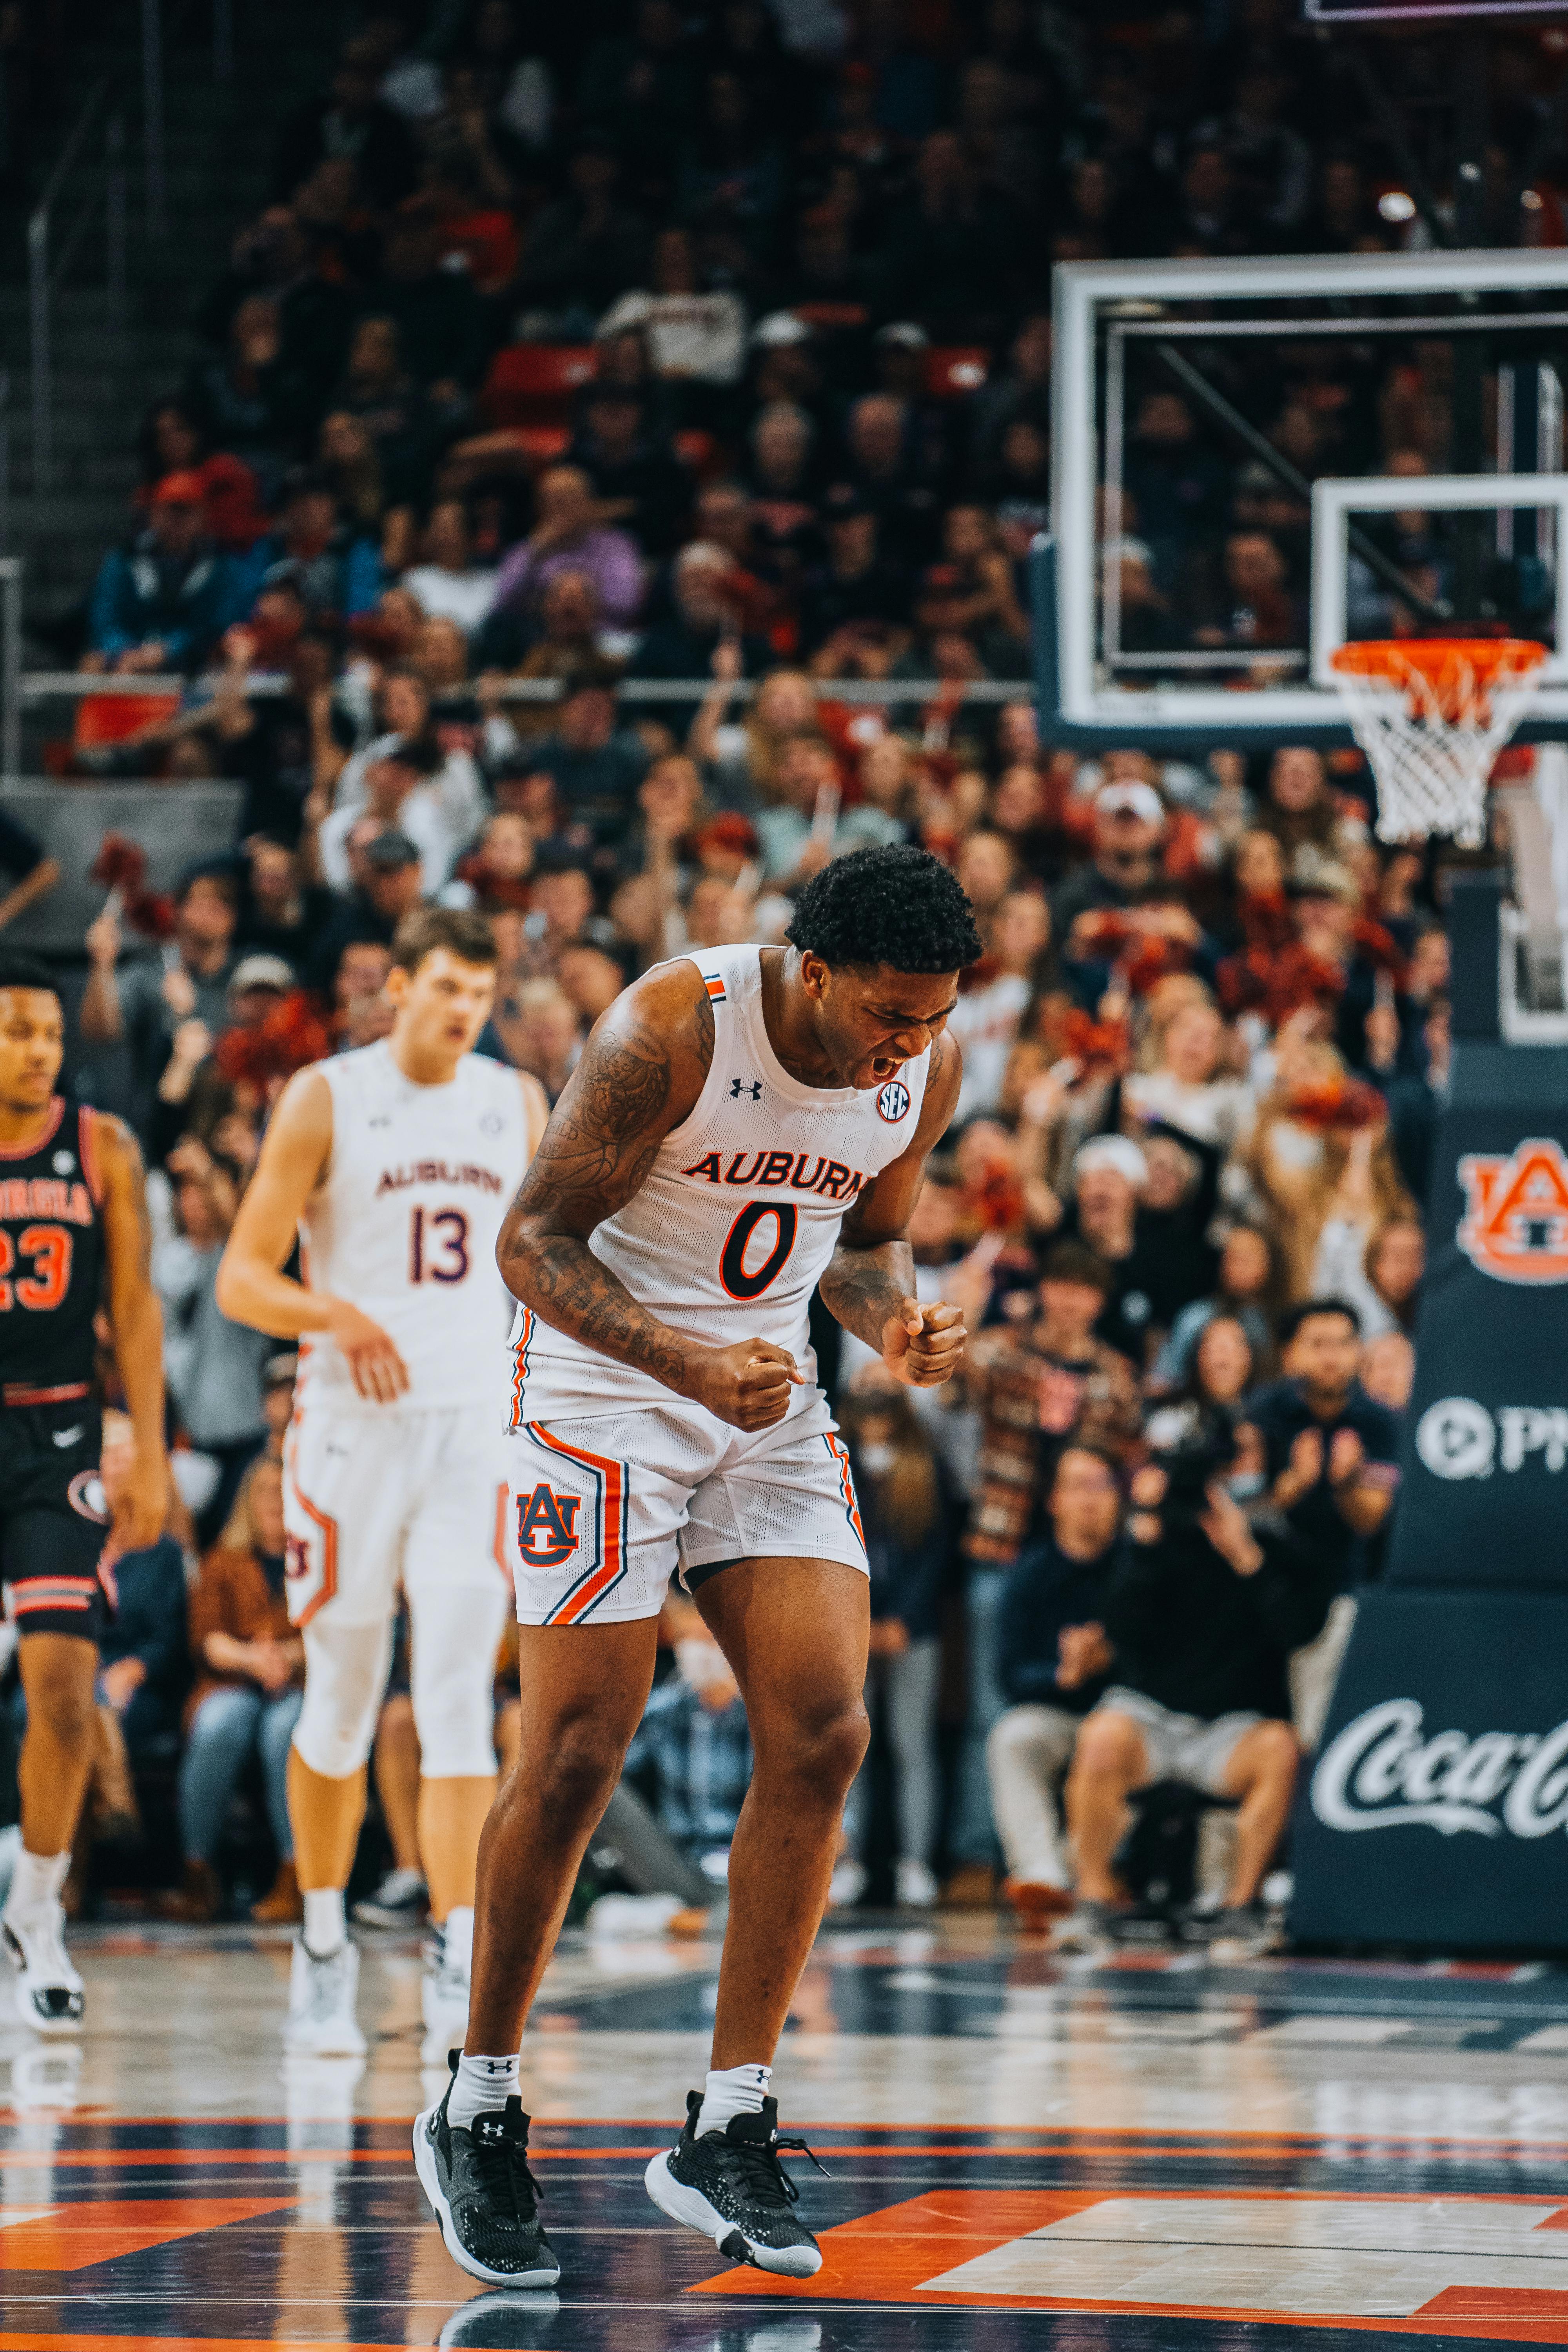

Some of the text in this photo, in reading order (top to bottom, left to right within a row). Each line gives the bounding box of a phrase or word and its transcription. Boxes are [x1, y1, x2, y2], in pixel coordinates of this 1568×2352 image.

[880, 1083, 908, 1120] SEC
[375, 1158, 502, 1199] AUBURN
[0, 1225, 74, 1311] 3
[410, 1204, 472, 1285] 13
[719, 1200, 797, 1301] 0
